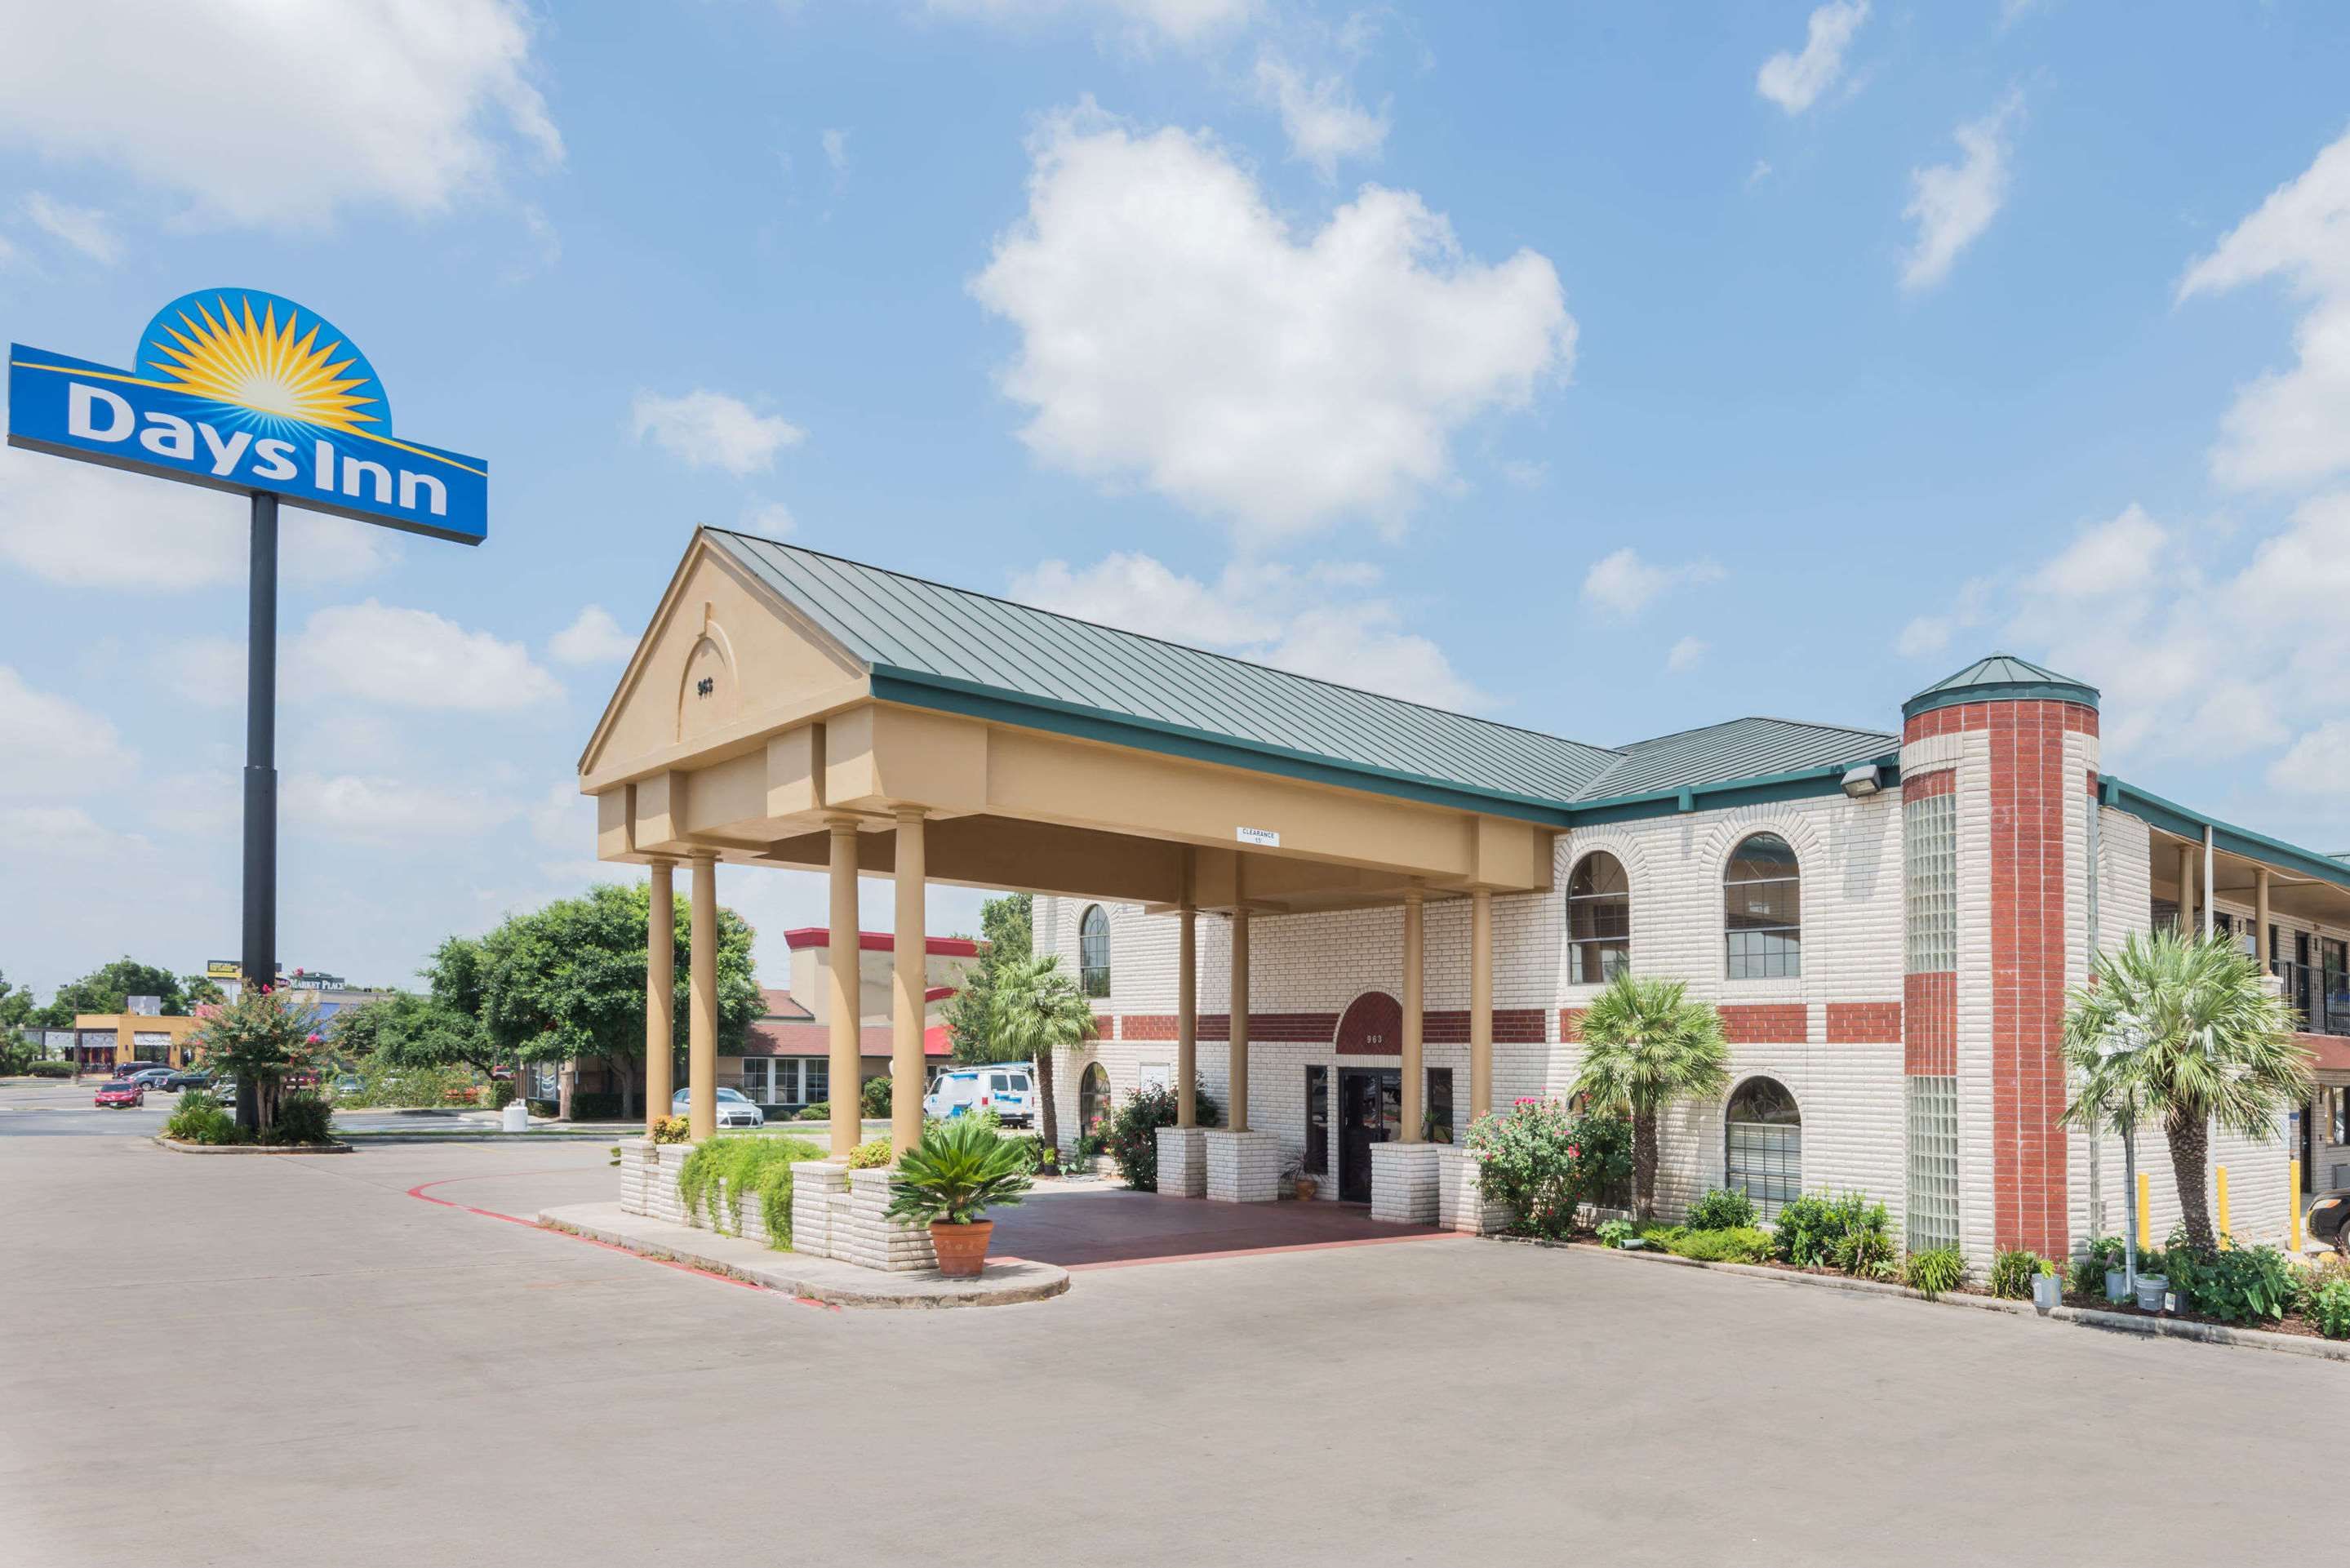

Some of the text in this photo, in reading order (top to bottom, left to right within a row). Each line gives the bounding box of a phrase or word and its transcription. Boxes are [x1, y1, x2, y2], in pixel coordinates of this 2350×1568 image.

[69, 381, 447, 516] Days Inn
[1242, 828, 1274, 839] CLEARANCE
[1366, 1034, 1382, 1044] 963
